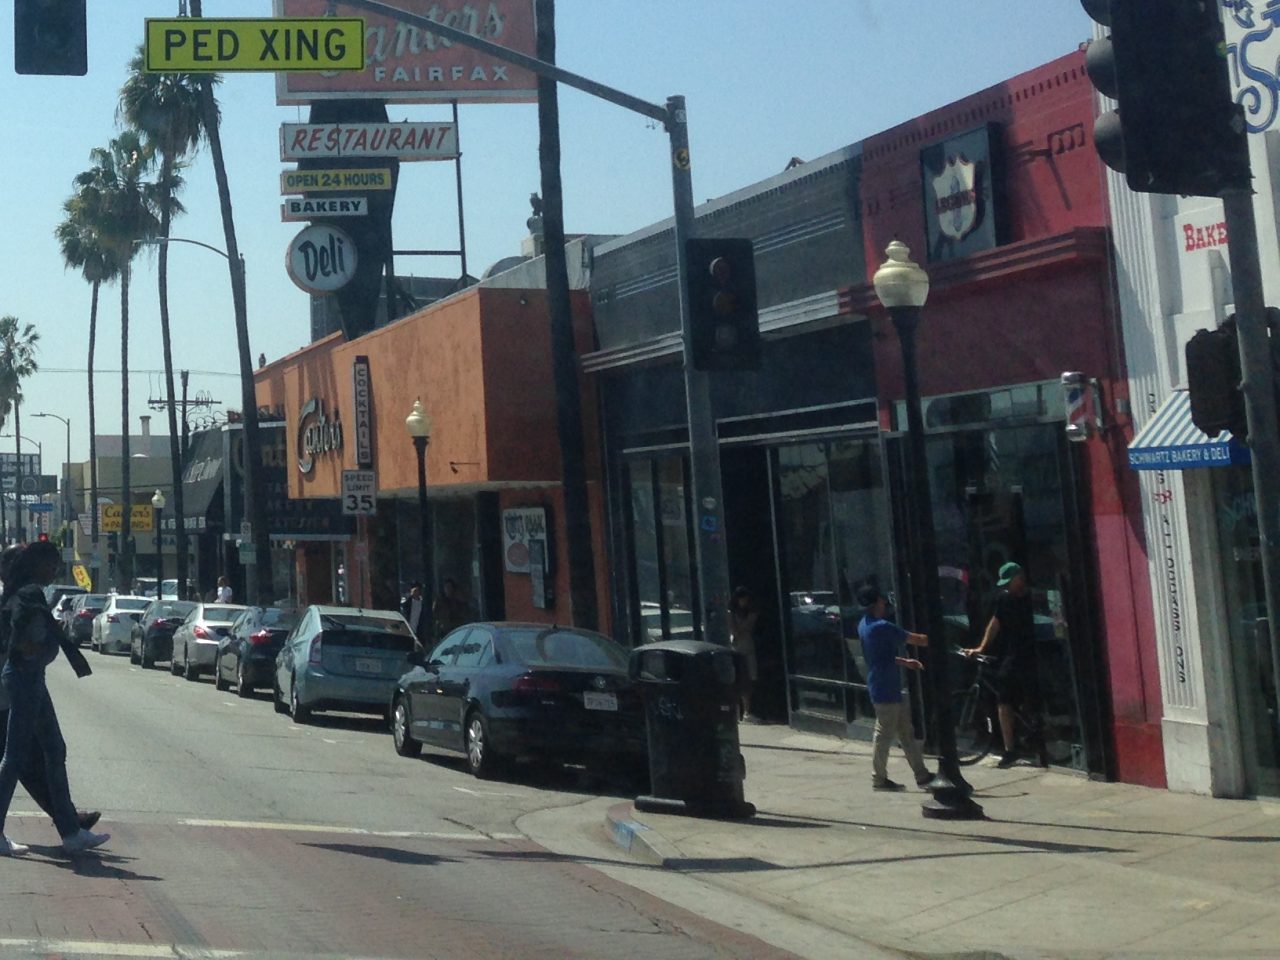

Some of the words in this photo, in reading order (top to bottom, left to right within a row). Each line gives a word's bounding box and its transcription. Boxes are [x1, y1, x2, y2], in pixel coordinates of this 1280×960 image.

[164, 28, 240, 62] PED
[259, 28, 346, 62] XING
[374, 66, 508, 82] FAIRFAX
[291, 126, 452, 153] RESTAURANT
[287, 175, 318, 188] OPEN
[321, 173, 341, 187] 24
[344, 172, 385, 186] HOURS
[290, 200, 361, 213] BAKERY
[1183, 222, 1228, 252] BAKE
[298, 233, 345, 282] Deli
[357, 368, 369, 460] COCKTAILS
[1129, 450, 1170, 464] SCHWARTZ
[1171, 448, 1201, 463] BAKERY
[1203, 448, 1210, 461] &
[1210, 446, 1230, 460] DELI
[344, 474, 373, 482] SPEED
[346, 495, 373, 511] 35
